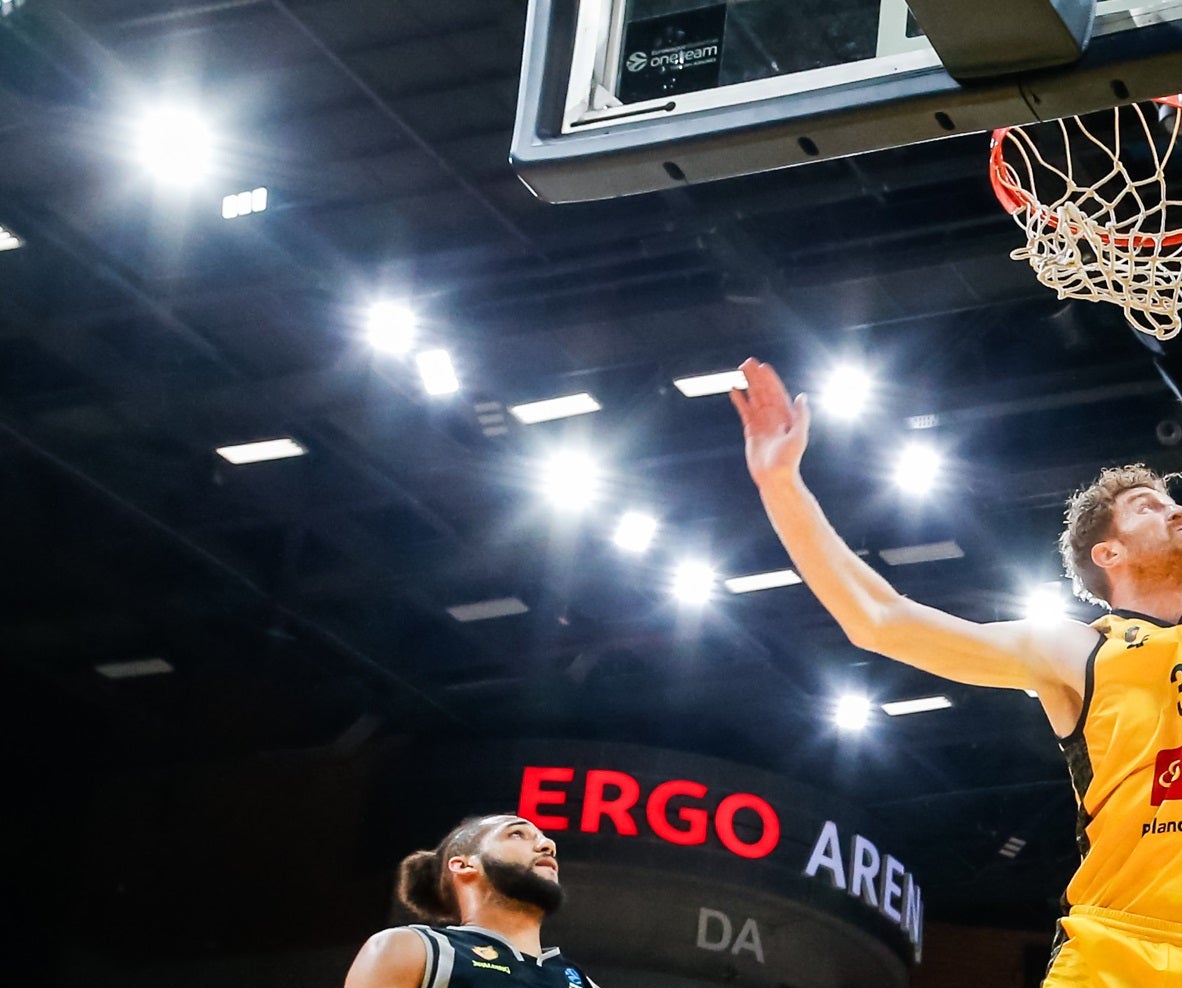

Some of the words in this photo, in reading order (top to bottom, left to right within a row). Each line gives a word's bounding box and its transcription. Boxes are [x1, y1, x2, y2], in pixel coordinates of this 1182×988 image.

[517, 766, 781, 859] ERGO
[803, 820, 924, 964] AREN
[697, 907, 765, 964] DA
